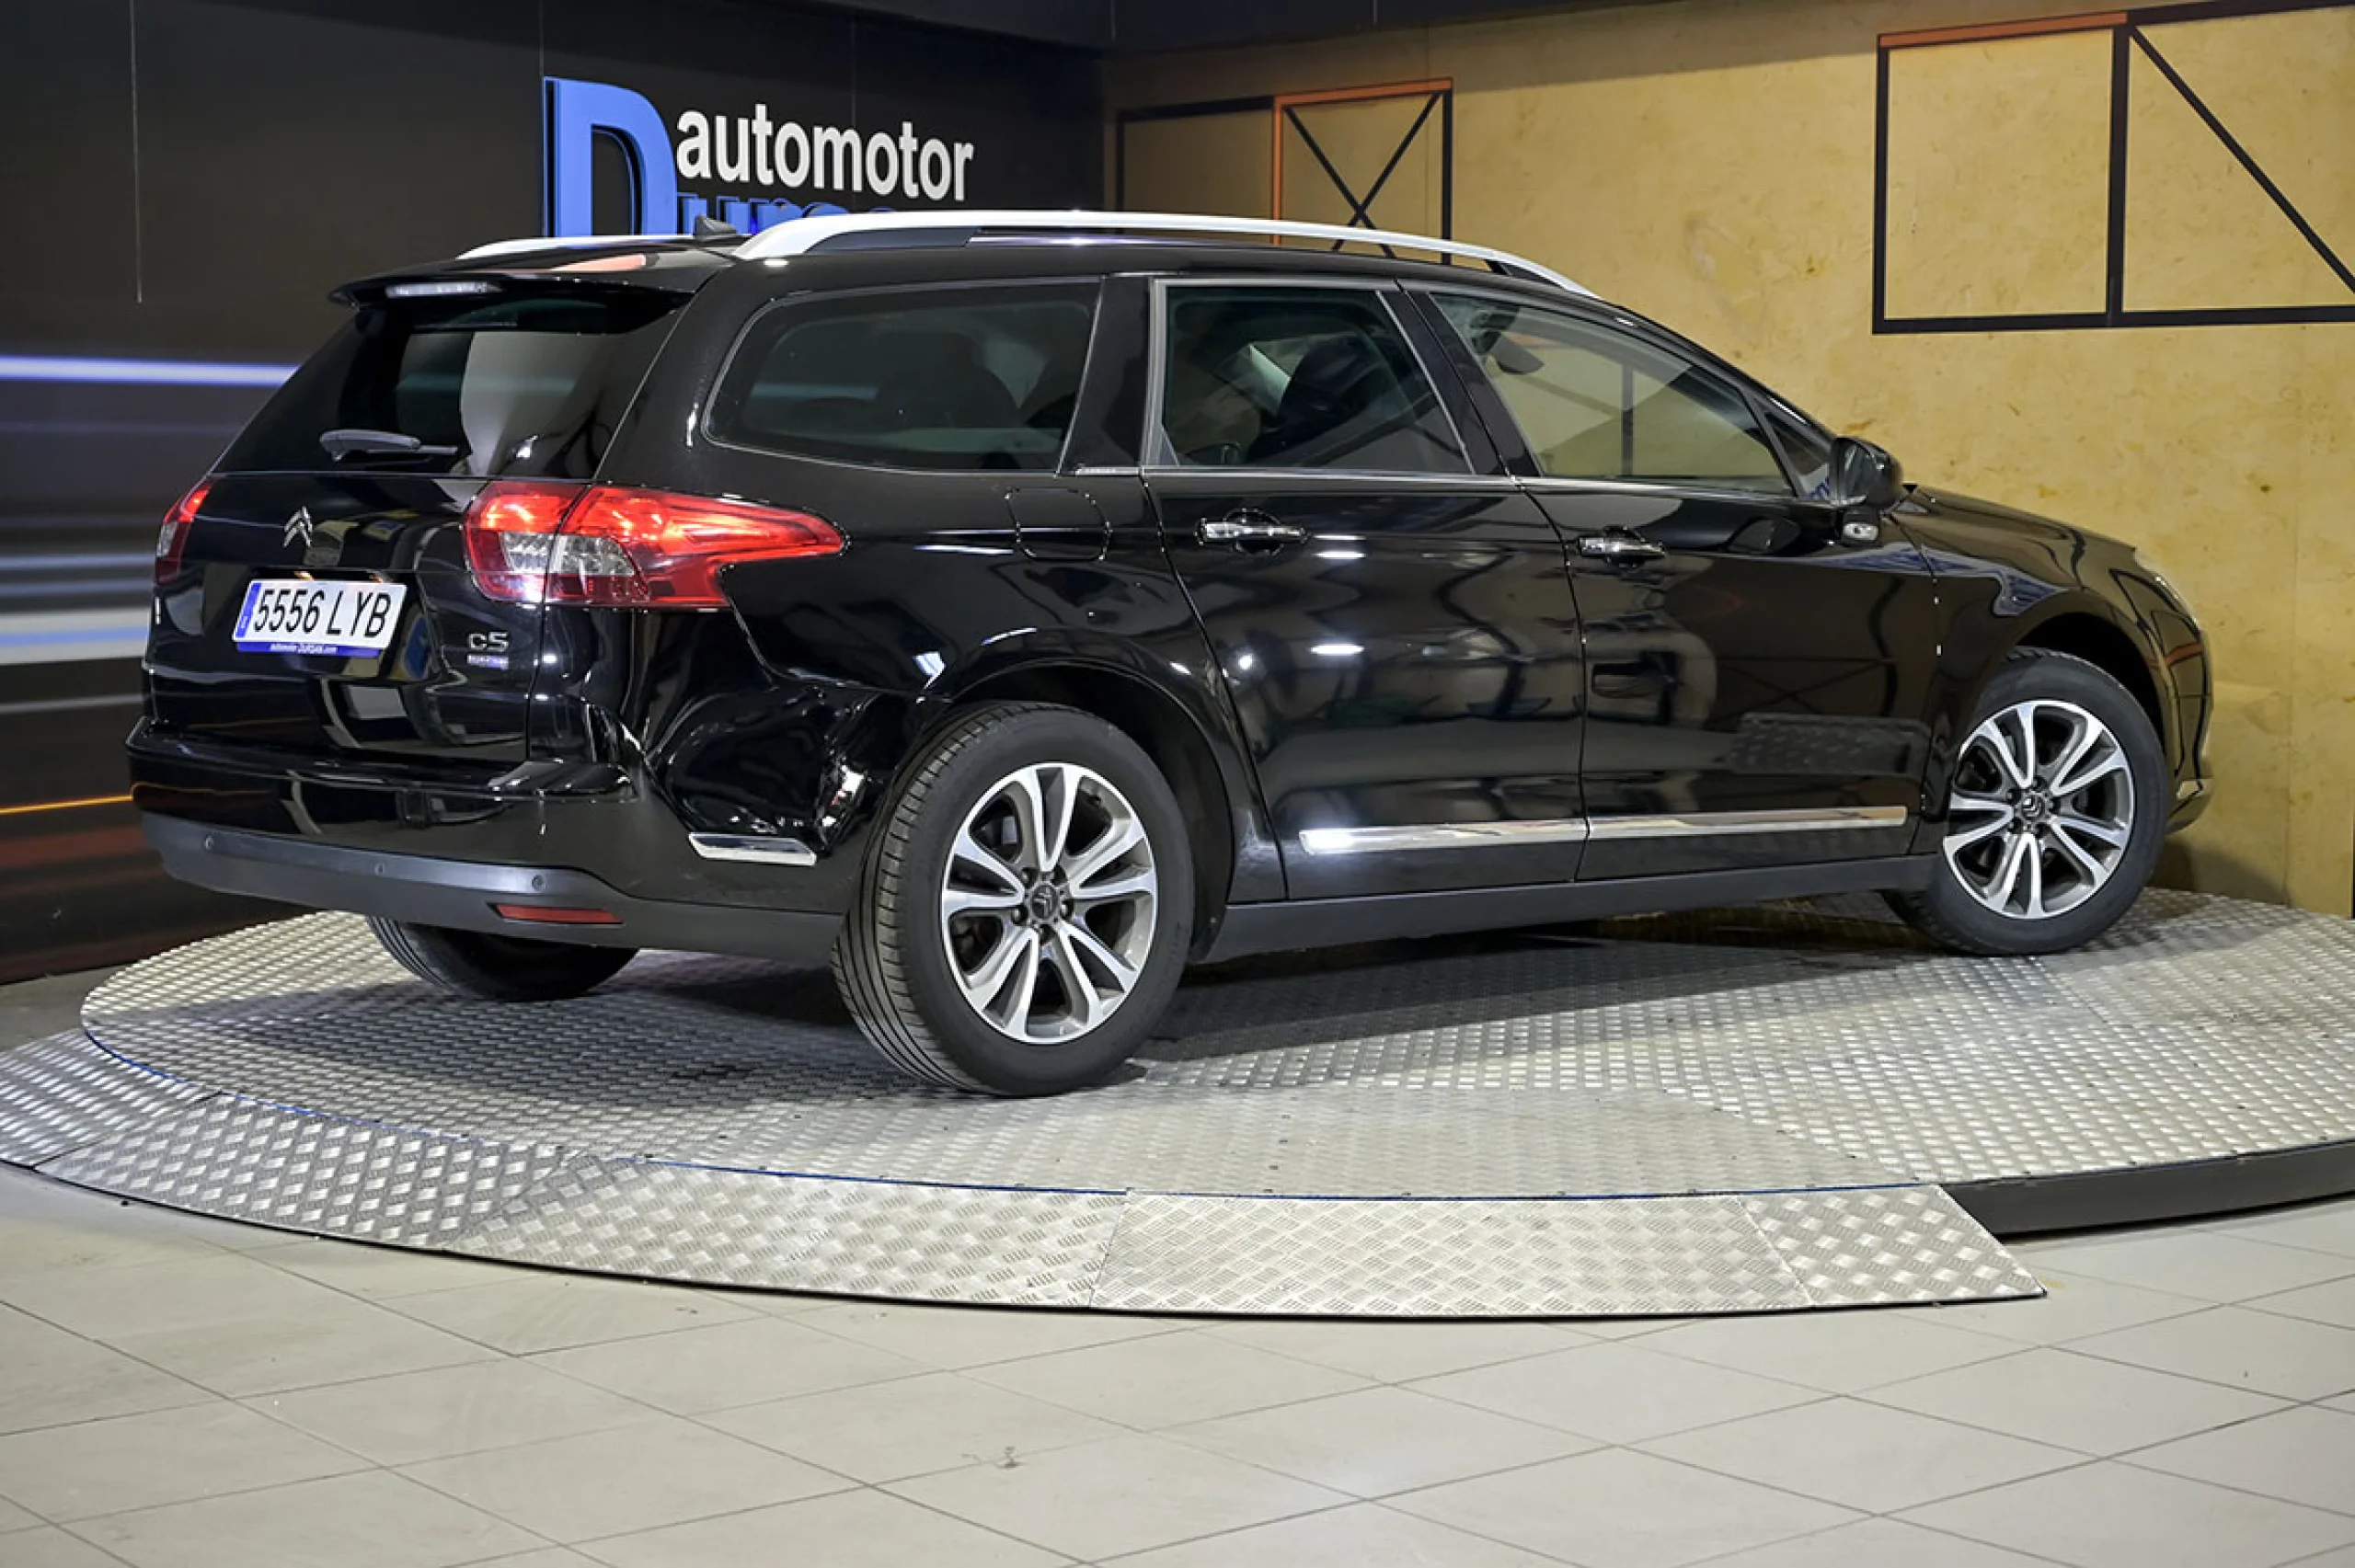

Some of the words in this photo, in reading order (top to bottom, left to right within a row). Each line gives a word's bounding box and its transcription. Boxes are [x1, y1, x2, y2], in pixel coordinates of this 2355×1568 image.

[676, 104, 973, 200] automotor
[254, 589, 325, 634] 5556
[326, 589, 392, 637] LYB
[468, 631, 509, 652] C5
